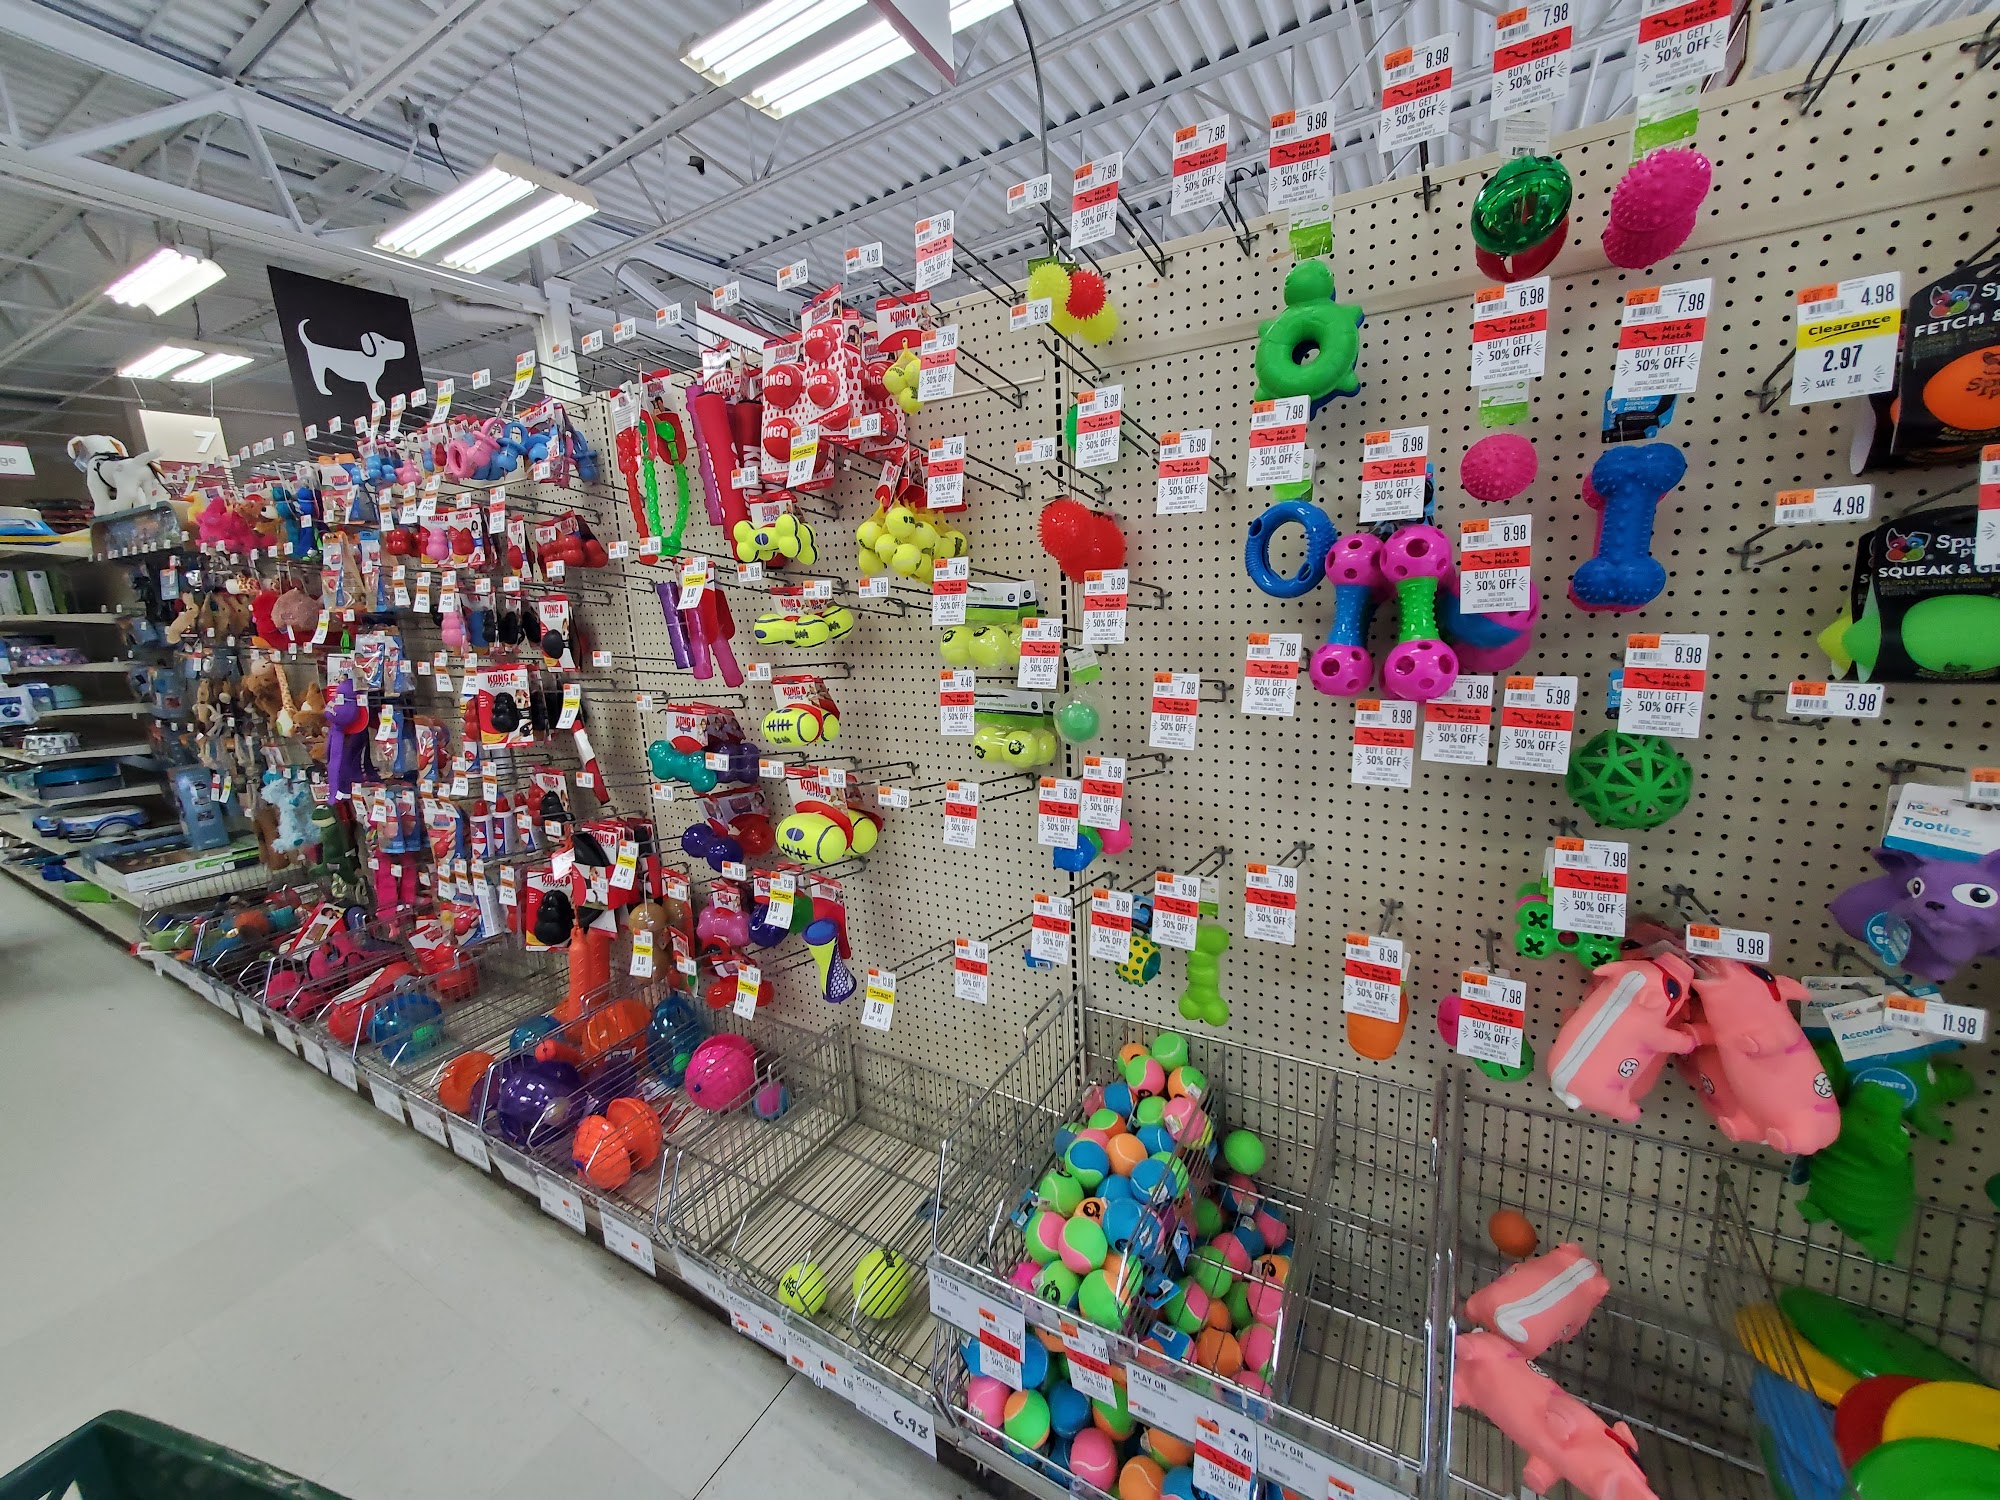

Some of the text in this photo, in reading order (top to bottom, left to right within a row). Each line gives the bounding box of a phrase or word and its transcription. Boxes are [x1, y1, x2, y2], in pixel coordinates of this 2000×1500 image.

[1543, 3, 1568, 28] 7.98
[1655, 38, 1673, 50] BUY
[1686, 26, 1706, 41] GET
[1426, 46, 1449, 69] 8.98
[1656, 36, 1710, 64] 50% OFF
[1510, 67, 1554, 91] 50% OFF
[1307, 111, 1327, 132] 9.98
[1396, 106, 1436, 126] 50% OFF
[1208, 124, 1226, 144] 7.98
[1102, 164, 1116, 182] 7.98
[1282, 168, 1318, 187] 50% OFF
[1033, 182, 1048, 199] 3.98
[1184, 175, 1216, 193] 50% OFF
[938, 218, 951, 235] 2.98
[1520, 287, 1544, 307] 6.98
[1677, 292, 1704, 313] 7.98
[1860, 283, 1894, 306] 4.98
[890, 310, 910, 323] KONG
[1034, 304, 1048, 320] 5.98
[1808, 316, 1890, 337] Clearance
[1914, 314, 1985, 338] FETCH
[1662, 332, 1692, 340] Match
[1488, 344, 1532, 362] 50% OFF
[1635, 349, 1652, 358] BUY
[1664, 345, 1680, 356] GET
[1822, 344, 1863, 372] 2.97
[1636, 355, 1686, 372] 50% OFF
[1815, 378, 1836, 389] SAVE
[1104, 393, 1118, 409] 6.98
[1285, 404, 1304, 421] 7.98
[194, 430, 218, 454] 7
[1086, 437, 1112, 450] 50% OFF
[1189, 438, 1206, 454] 6.98
[1402, 436, 1423, 454] 8.98
[1040, 444, 1053, 459] 7.98
[1260, 454, 1293, 466] 50% OFF
[1168, 484, 1198, 496] 50% OFF
[1374, 488, 1412, 500] 50% OFF
[761, 504, 780, 516] KONG
[1832, 496, 1864, 516] 4.98
[1503, 525, 1526, 542] 8.98
[1936, 534, 1976, 555] Spu
[1494, 557, 1520, 565] Match
[954, 564, 966, 576] 4.48
[1474, 571, 1490, 580] BUY
[1498, 570, 1512, 578] GET
[1878, 565, 1953, 578] SQUEAK
[1958, 564, 1972, 575] &
[1110, 577, 1126, 591] 9.98
[1476, 578, 1517, 591] 50% OFF
[544, 604, 559, 614] KONG
[780, 599, 796, 608] KONG
[1092, 618, 1118, 628] 50% OFF
[1047, 625, 1060, 638] 4.98
[1280, 642, 1296, 657] 7.98
[1674, 646, 1702, 664] 8.98
[488, 673, 509, 684] KONG
[960, 676, 972, 688] 4.48
[1662, 680, 1690, 688] Match
[782, 686, 801, 696] KONG
[1180, 681, 1196, 696] 7.98
[1254, 686, 1286, 697] 50% OFF
[1466, 684, 1489, 700] 3.98
[1546, 688, 1570, 705] 5.98
[1636, 690, 1654, 700] BUY
[1666, 692, 1681, 701] GET
[1638, 700, 1686, 714] 50% OFF
[1845, 692, 1876, 712] 3.98
[675, 716, 691, 726] KONG
[1392, 709, 1412, 724] 8.98
[1438, 732, 1477, 744] 50% OFF
[1514, 739, 1556, 752] 50% OFF
[1366, 756, 1402, 767] 50% OFF
[1108, 766, 1122, 779] 6.98
[800, 778, 825, 794] KONG
[1063, 786, 1077, 800] 6.98
[1604, 850, 1626, 868] 7.98
[1277, 873, 1294, 888] 7.98
[1182, 883, 1197, 898] 9.98
[1116, 900, 1130, 913] 8.98
[1574, 900, 1616, 914] 50% OFF
[1736, 937, 1764, 956] 9.98
[1378, 947, 1398, 964] 8.98
[1356, 986, 1389, 1002] 50% OFF
[1501, 988, 1522, 1005] 7.98
[1942, 1013, 1976, 1036] 11.98
[1473, 1029, 1510, 1046] 50% OFF
[1133, 1368, 1167, 1392] PLAY ON
[893, 1409, 929, 1440] 6.98
[1233, 1442, 1253, 1464] 3.48
[1264, 1434, 1304, 1460] PLAY ON
